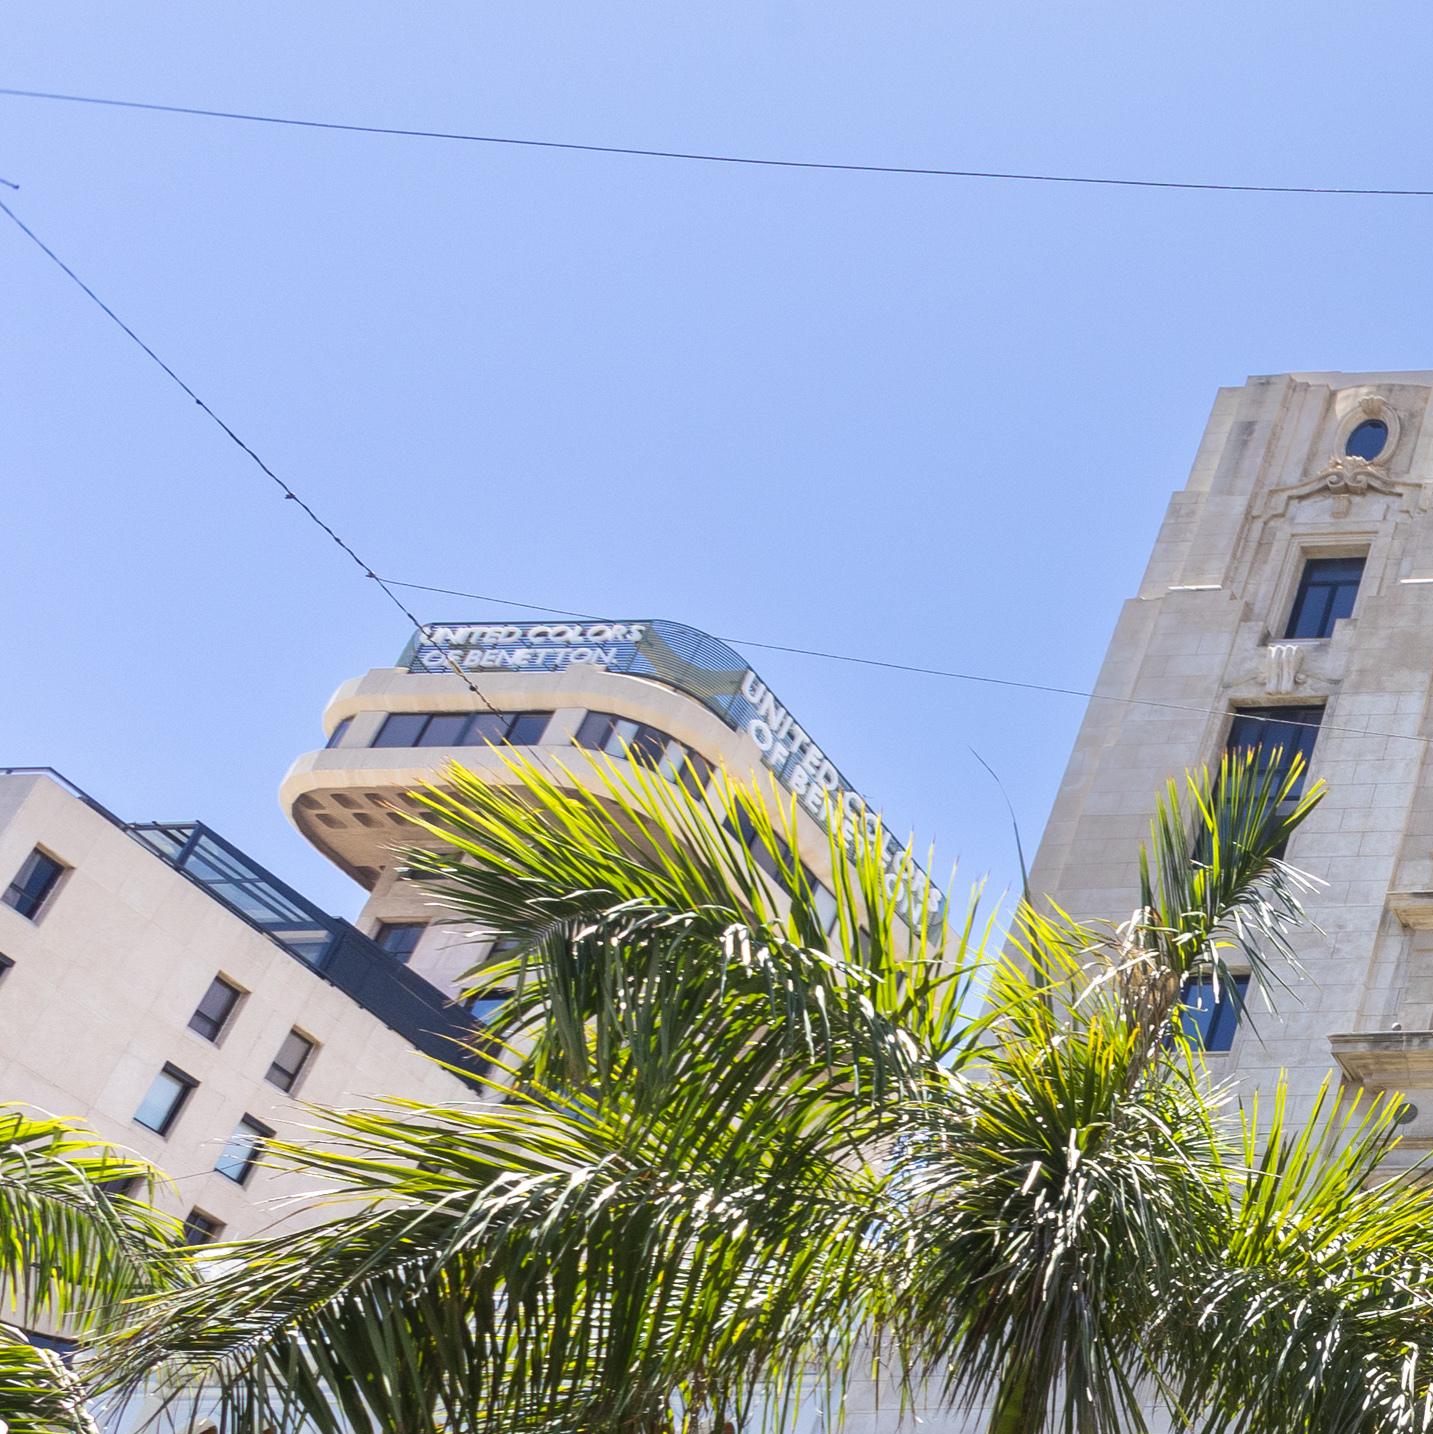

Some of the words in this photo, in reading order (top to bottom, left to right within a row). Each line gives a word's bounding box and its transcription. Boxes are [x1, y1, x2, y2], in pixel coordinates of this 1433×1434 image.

[421, 625, 521, 645] UNITED
[527, 623, 646, 644] COLORS
[741, 669, 838, 791] UNITED
[751, 719, 791, 767] OF
